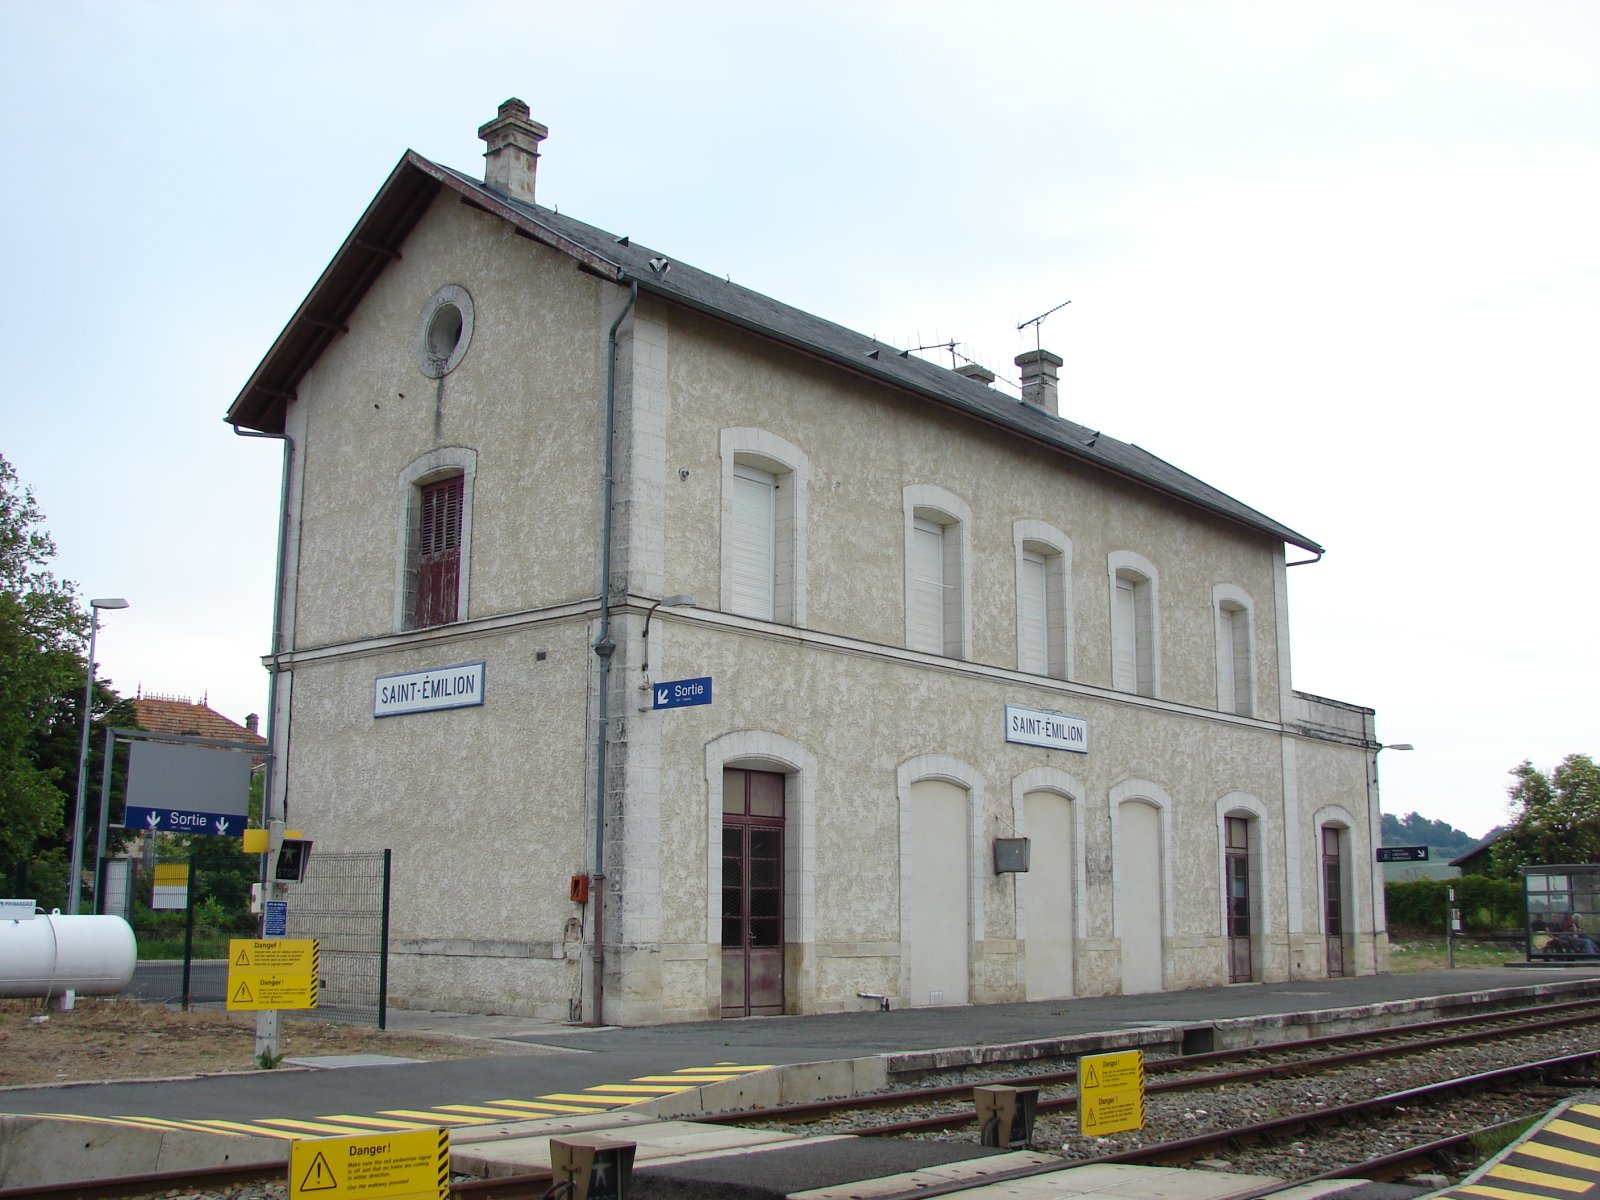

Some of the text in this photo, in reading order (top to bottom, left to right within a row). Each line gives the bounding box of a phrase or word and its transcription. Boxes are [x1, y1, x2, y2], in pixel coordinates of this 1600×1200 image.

[674, 683, 704, 697] Sortie
[170, 812, 207, 826] Sortie
[349, 1142, 391, 1156] Danger!
